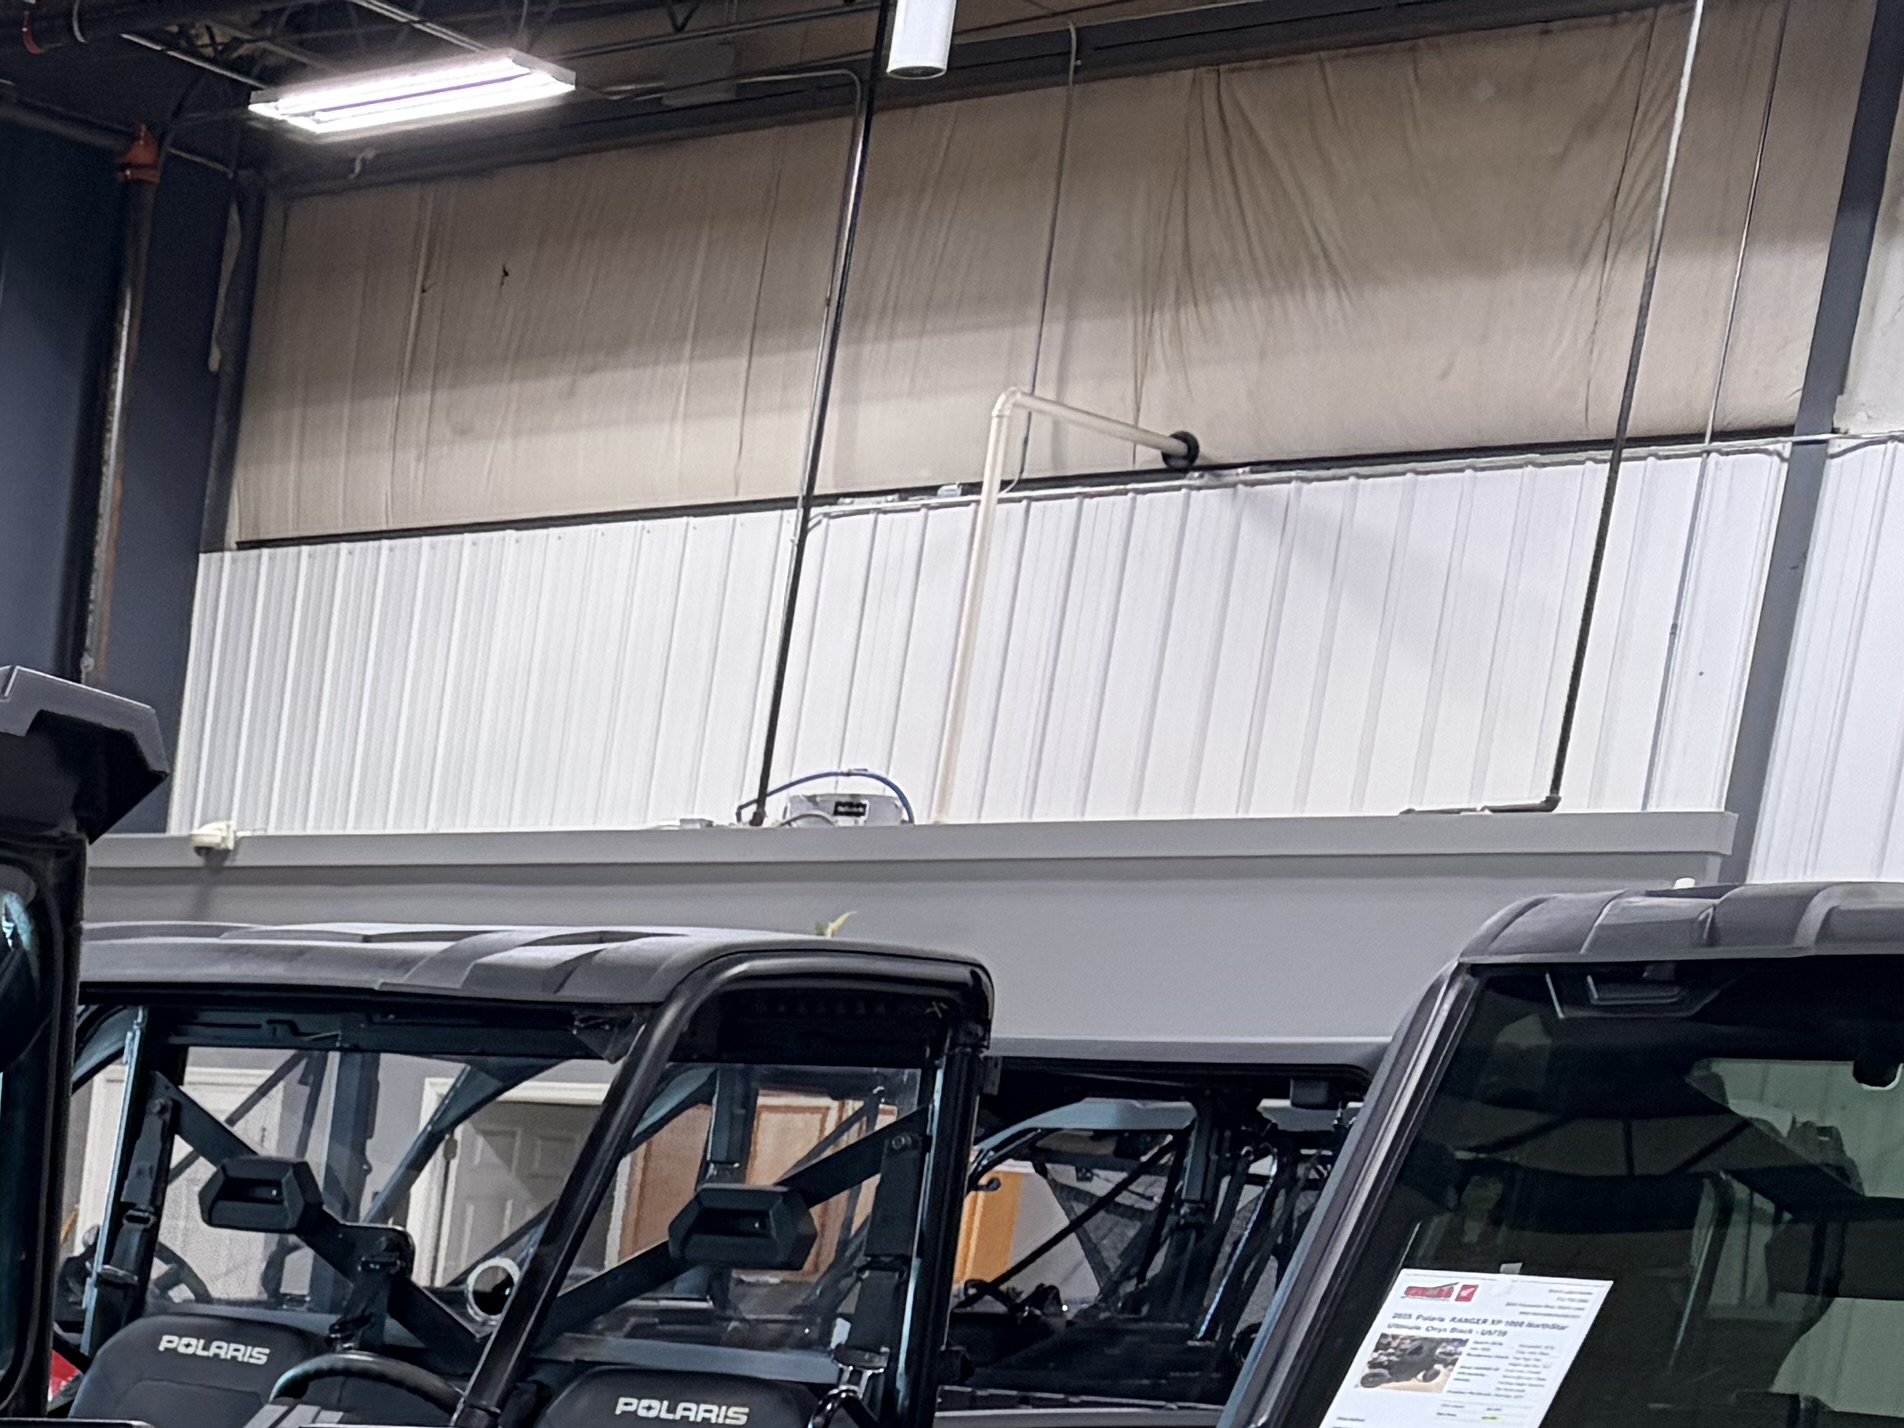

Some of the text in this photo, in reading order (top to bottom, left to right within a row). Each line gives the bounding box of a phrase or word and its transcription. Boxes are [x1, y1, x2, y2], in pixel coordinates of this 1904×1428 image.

[1415, 1314, 1445, 1323] Polaris
[1449, 1316, 1486, 1325] RANGER
[158, 1333, 270, 1366] POLARIS
[615, 1396, 749, 1426] POLARIS
